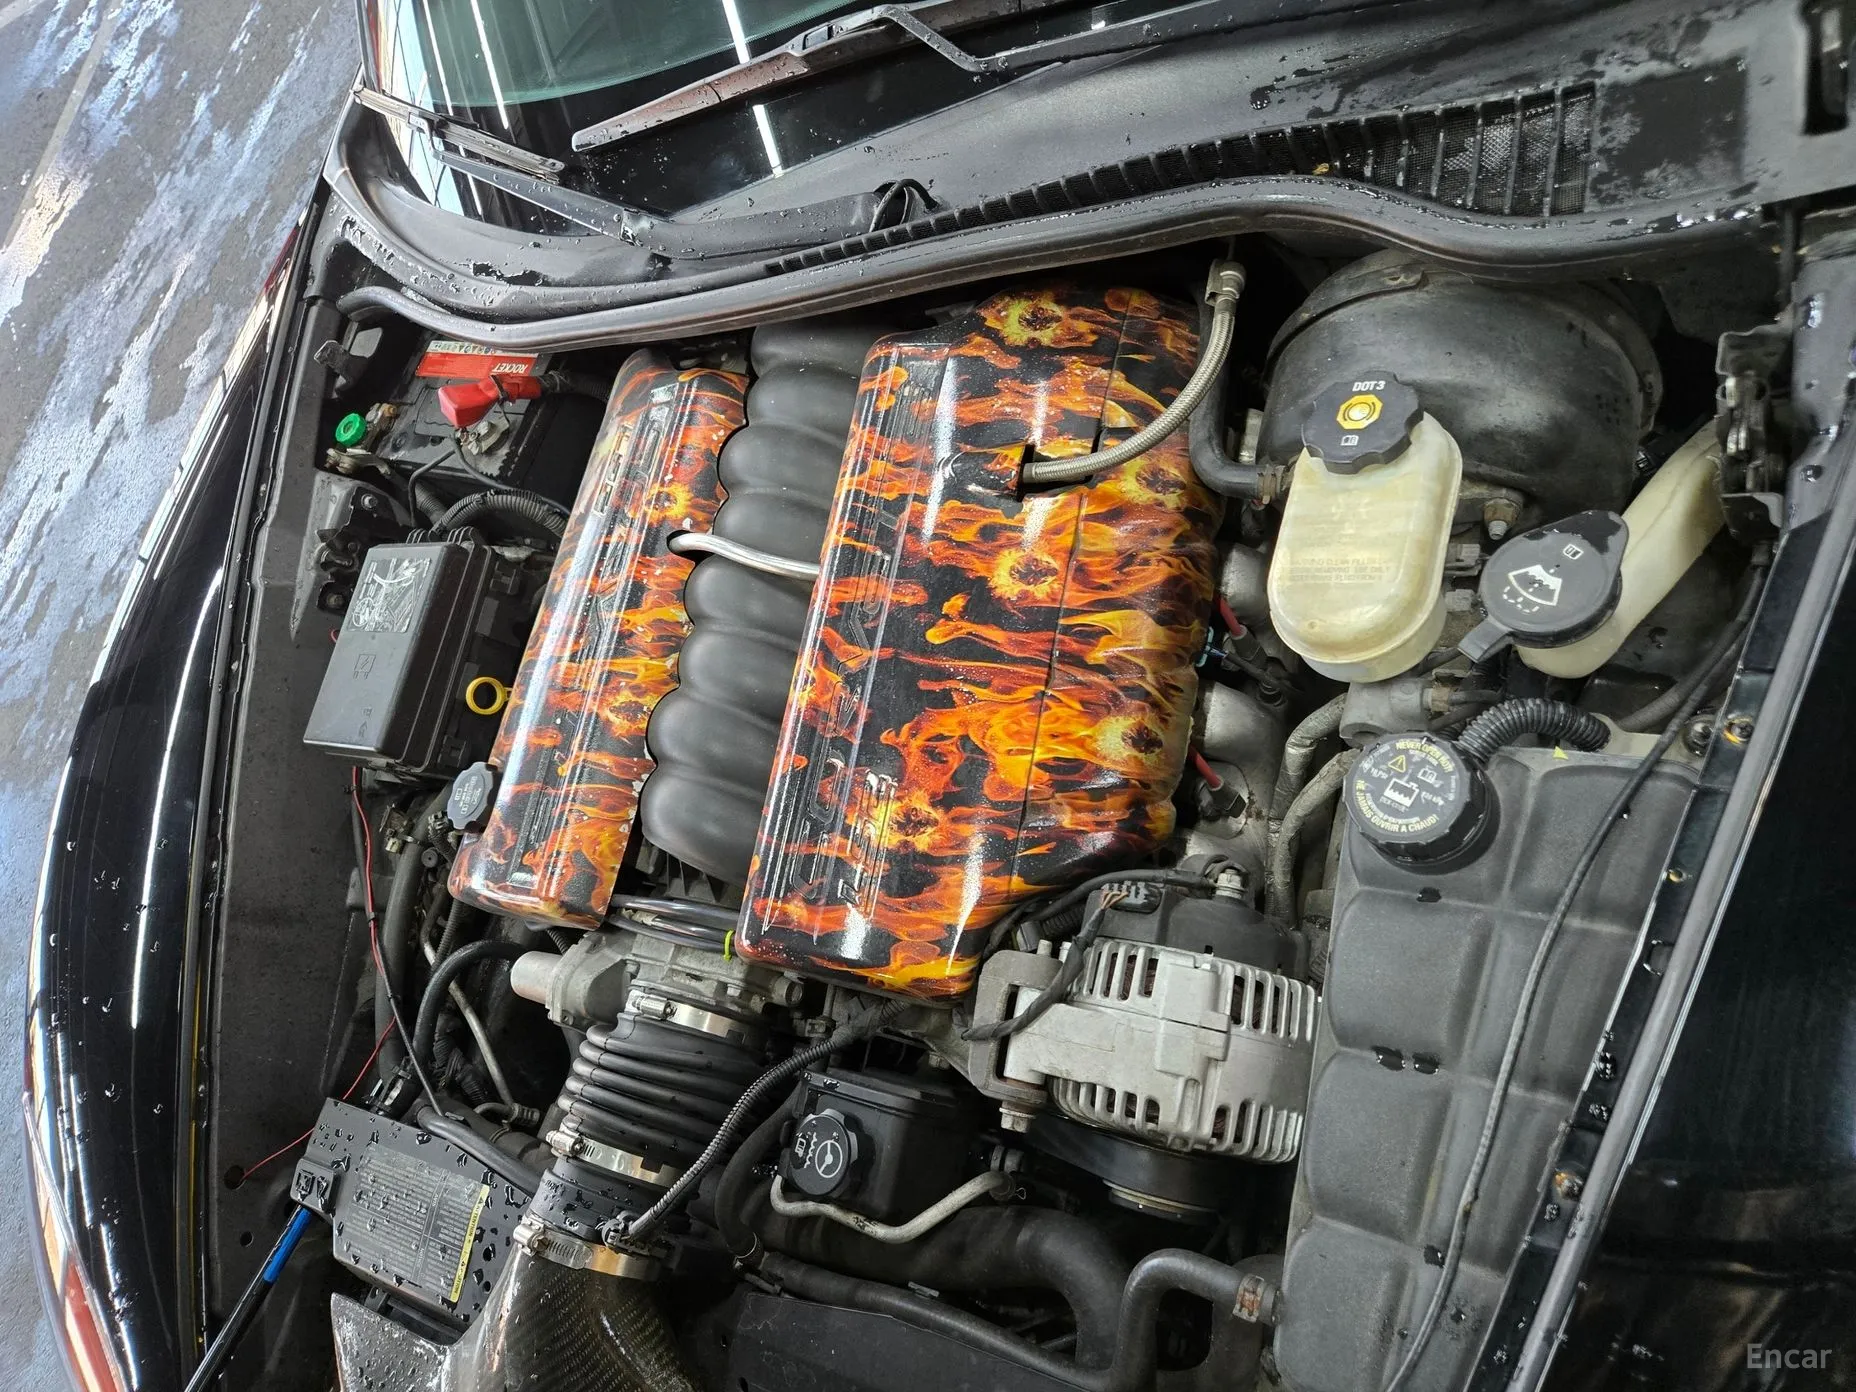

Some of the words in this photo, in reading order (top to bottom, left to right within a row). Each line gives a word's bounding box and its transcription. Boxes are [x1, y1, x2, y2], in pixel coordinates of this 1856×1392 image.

[491, 362, 529, 374] ROCKET
[1396, 740, 1422, 751] NEVER
[1421, 744, 1440, 760] OPEN
[1437, 754, 1454, 773] HOT!
[1356, 791, 1373, 818] JAMAIS
[1371, 816, 1399, 832] OUVRIR
[1400, 825, 1407, 833] A
[1408, 814, 1439, 832] CHAUD!
